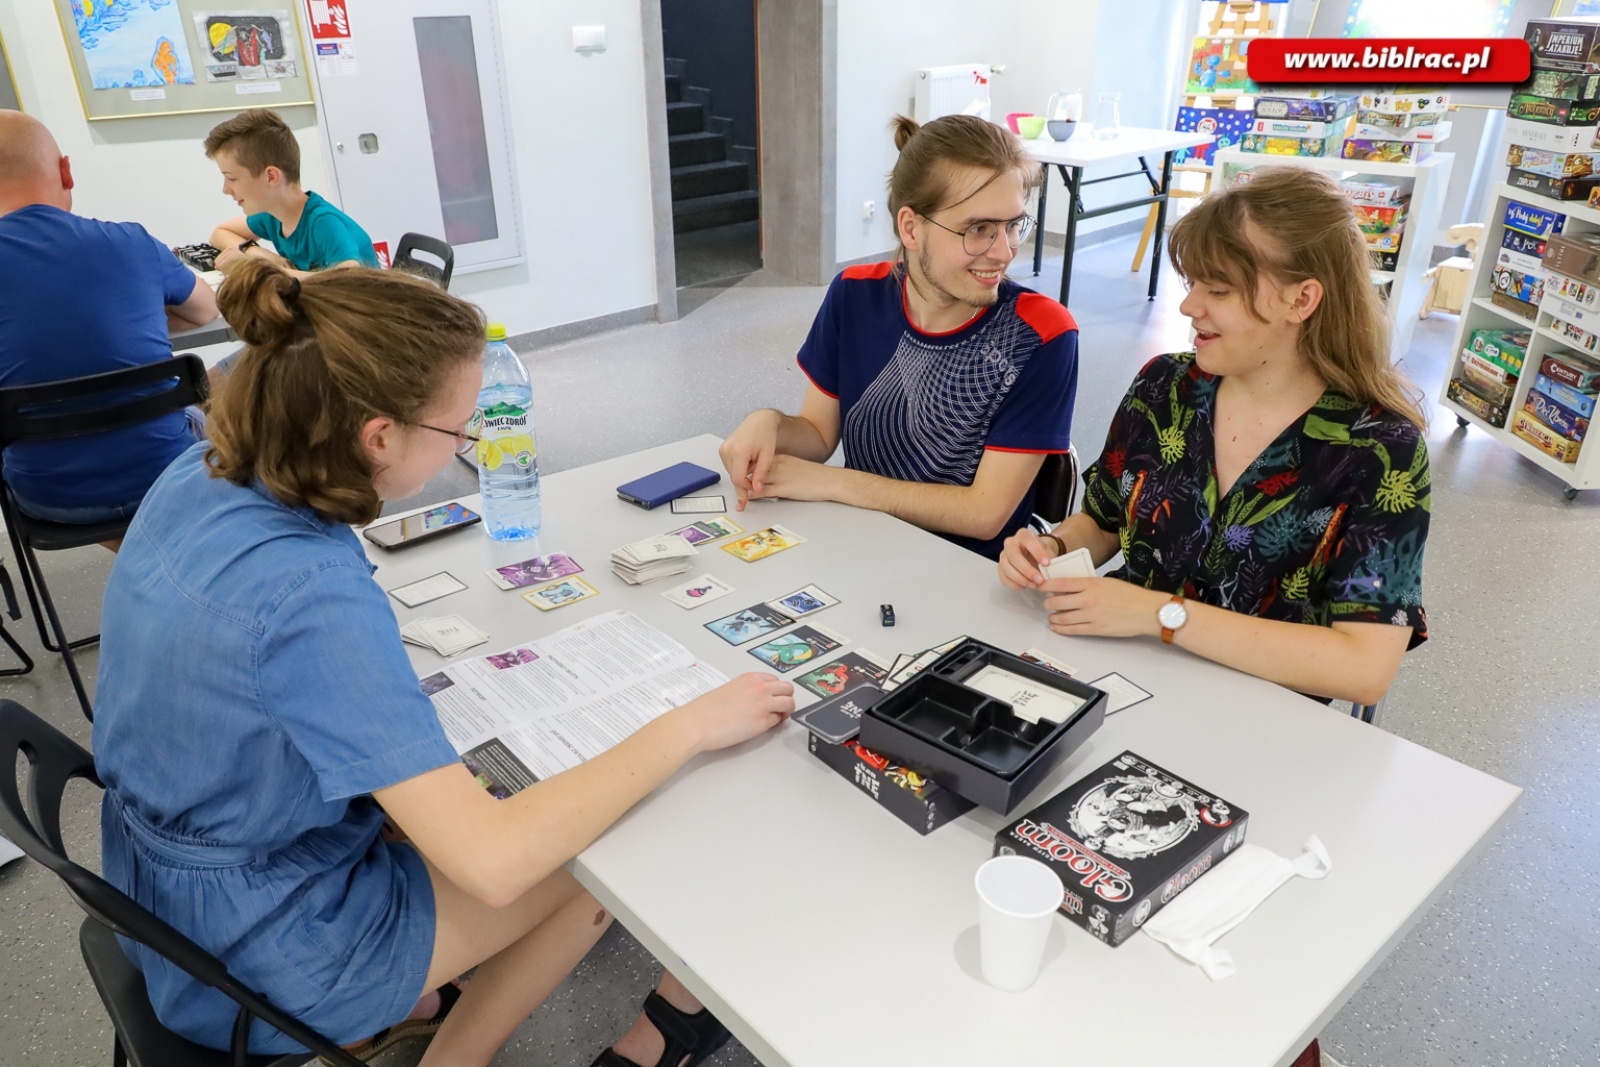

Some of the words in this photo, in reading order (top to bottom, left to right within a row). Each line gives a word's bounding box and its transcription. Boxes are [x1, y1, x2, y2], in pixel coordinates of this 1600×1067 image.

[1547, 33, 1584, 51] IMPERIUM
[1549, 44, 1579, 55] ATAKUJE
[1550, 363, 1577, 379] CENTURY
[483, 417, 503, 428] YWIEC
[506, 415, 526, 426] ZDRÓJ
[1010, 831, 1032, 846] BAKER
[1015, 819, 1134, 902] Gloom
[1033, 846, 1055, 862] KEITH
[1161, 855, 1212, 903] Gloom
